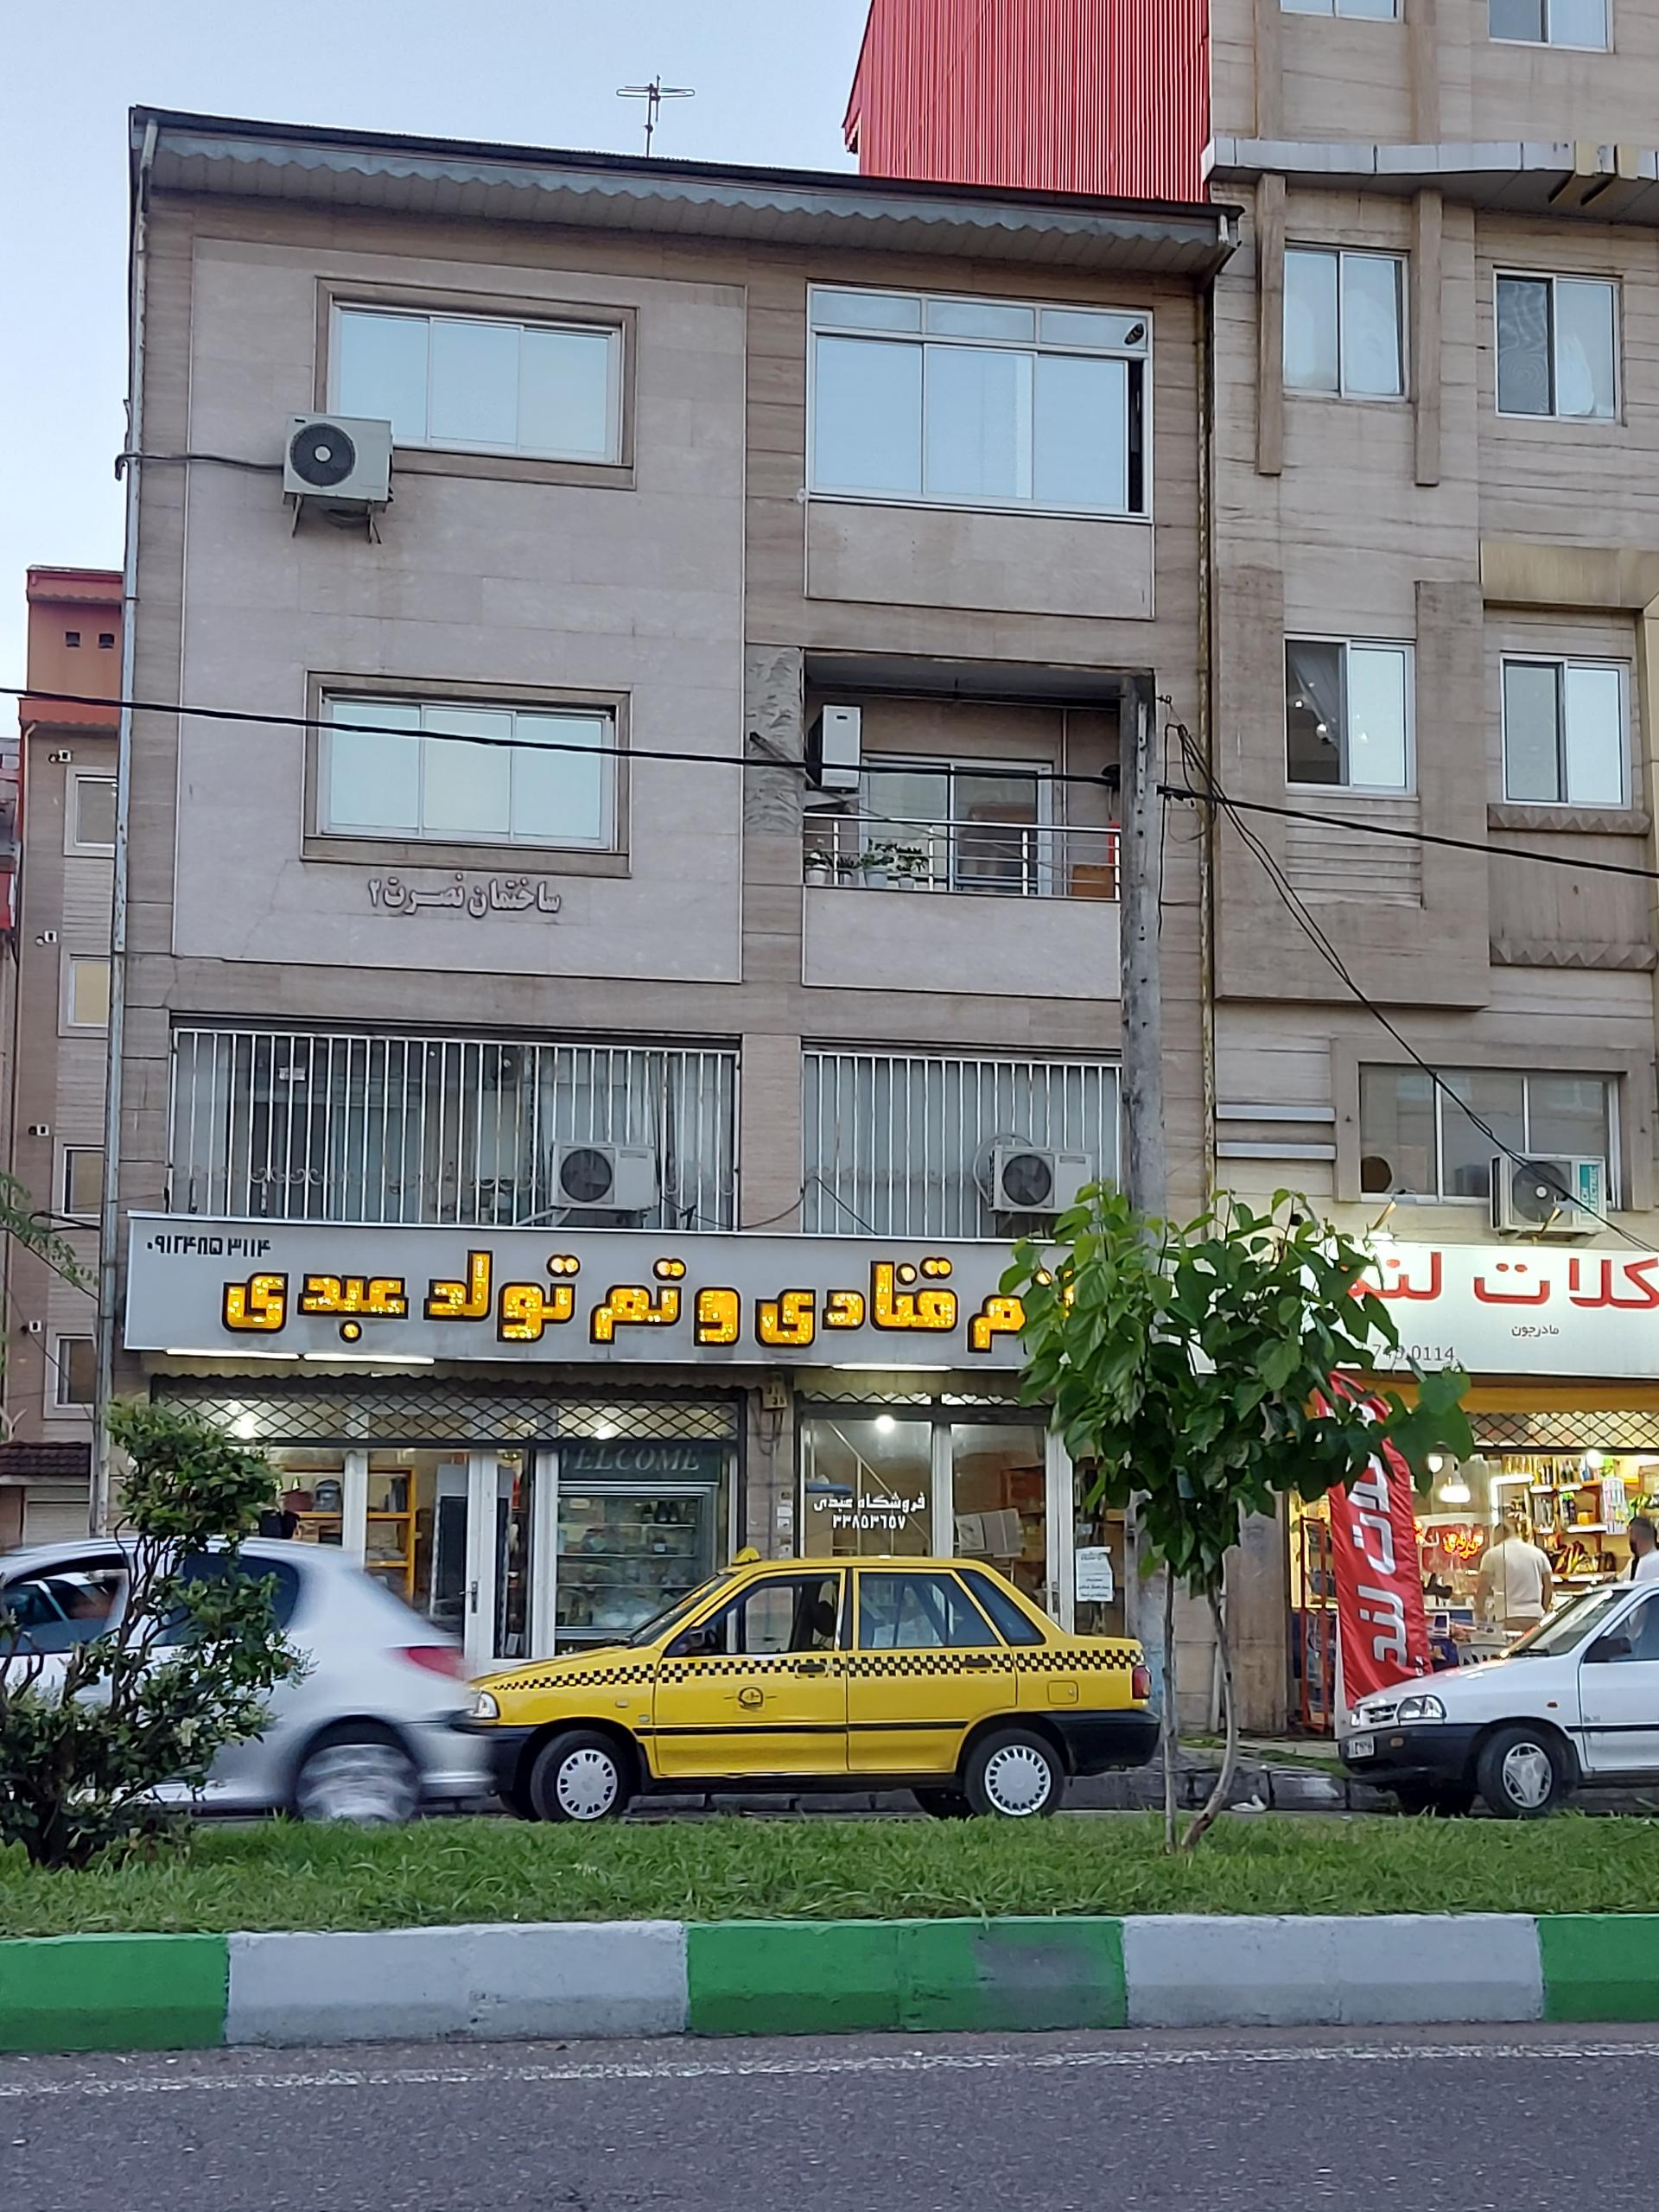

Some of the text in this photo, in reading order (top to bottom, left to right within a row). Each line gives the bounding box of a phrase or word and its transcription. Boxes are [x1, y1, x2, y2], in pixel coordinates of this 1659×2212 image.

[382, 873, 466, 915] نصرت
[467, 877, 562, 918] ساختمان
[222, 1272, 410, 1344] عبدی
[423, 1249, 582, 1344] تولد
[589, 1257, 688, 1346] تم
[754, 1256, 959, 1348] قنادی
[1473, 1256, 1659, 1310] کلات
[693, 1286, 741, 1347] و
[1510, 1324, 1560, 1338] مادرجون
[813, 1491, 925, 1513] فروشگاه عبدی
